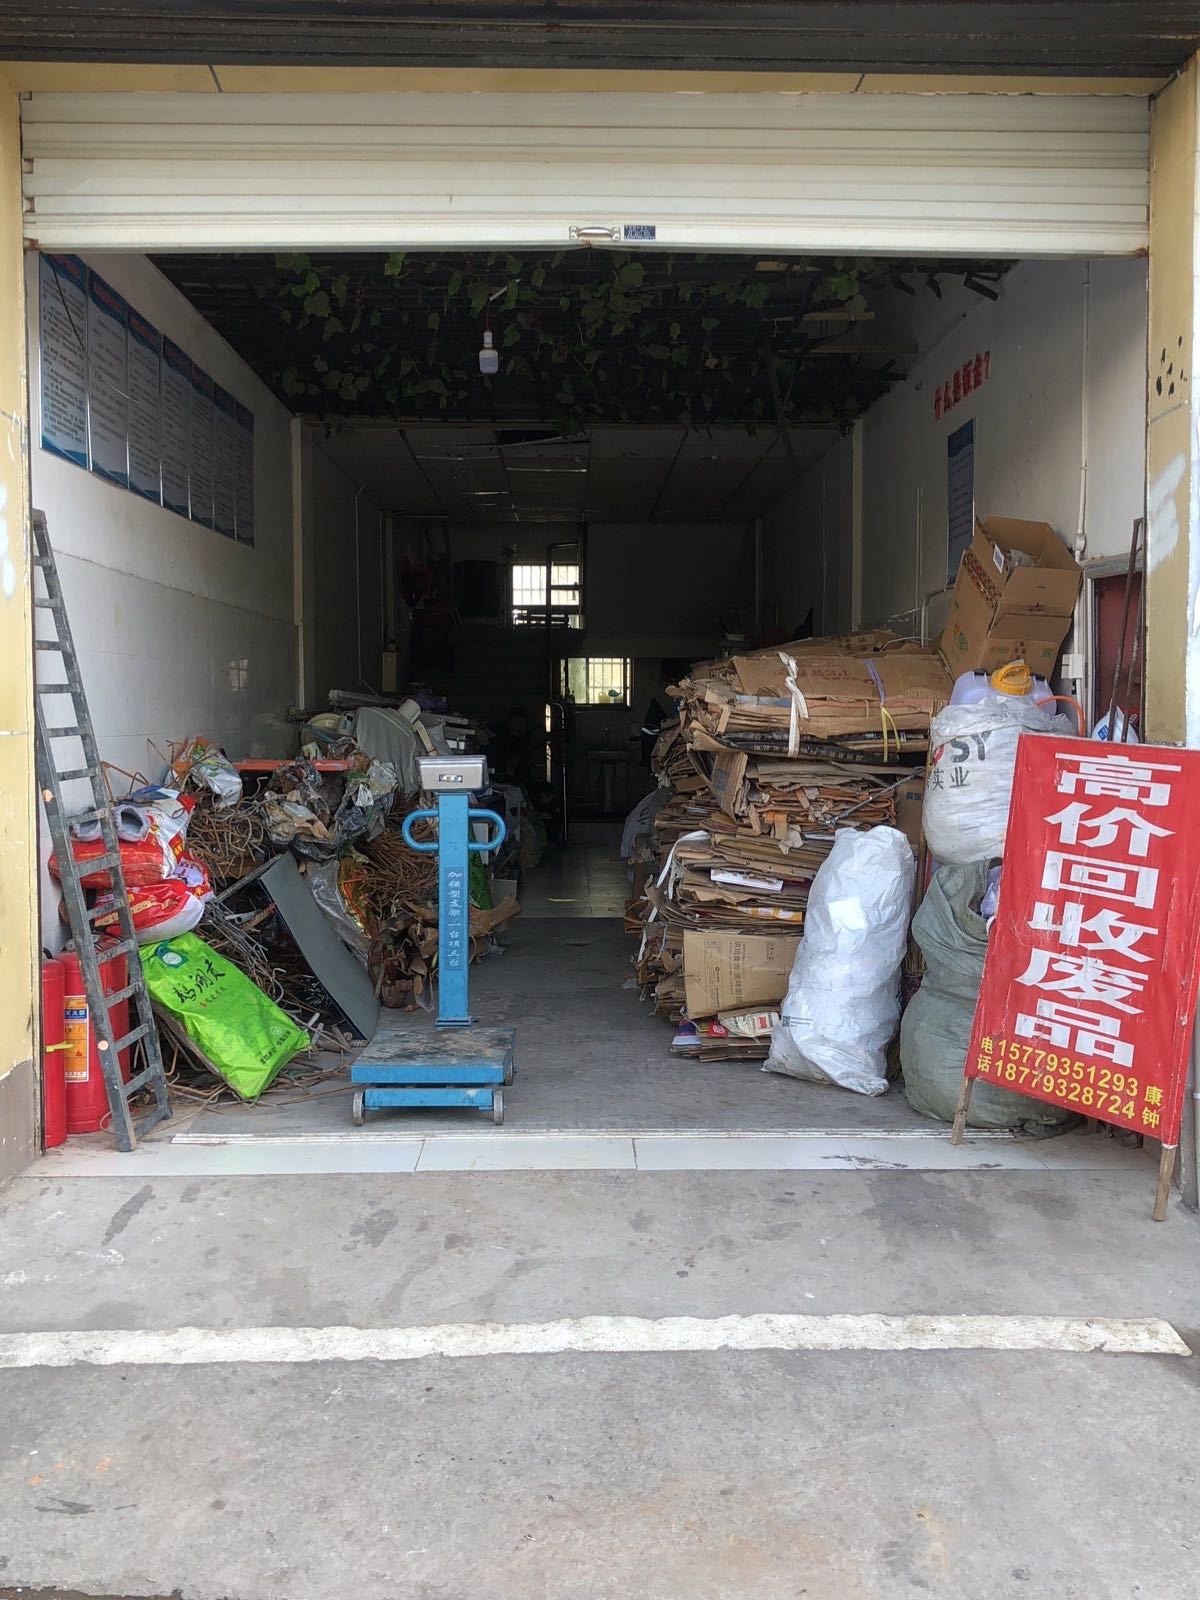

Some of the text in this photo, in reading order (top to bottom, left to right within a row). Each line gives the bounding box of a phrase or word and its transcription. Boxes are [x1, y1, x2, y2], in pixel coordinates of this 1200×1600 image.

[1014, 752, 1182, 1068] 高价回收废品
[977, 1036, 994, 1073] 电话
[998, 1039, 1163, 1107] 15779351293 康
[995, 1060, 1160, 1128] 18779328724 钟
